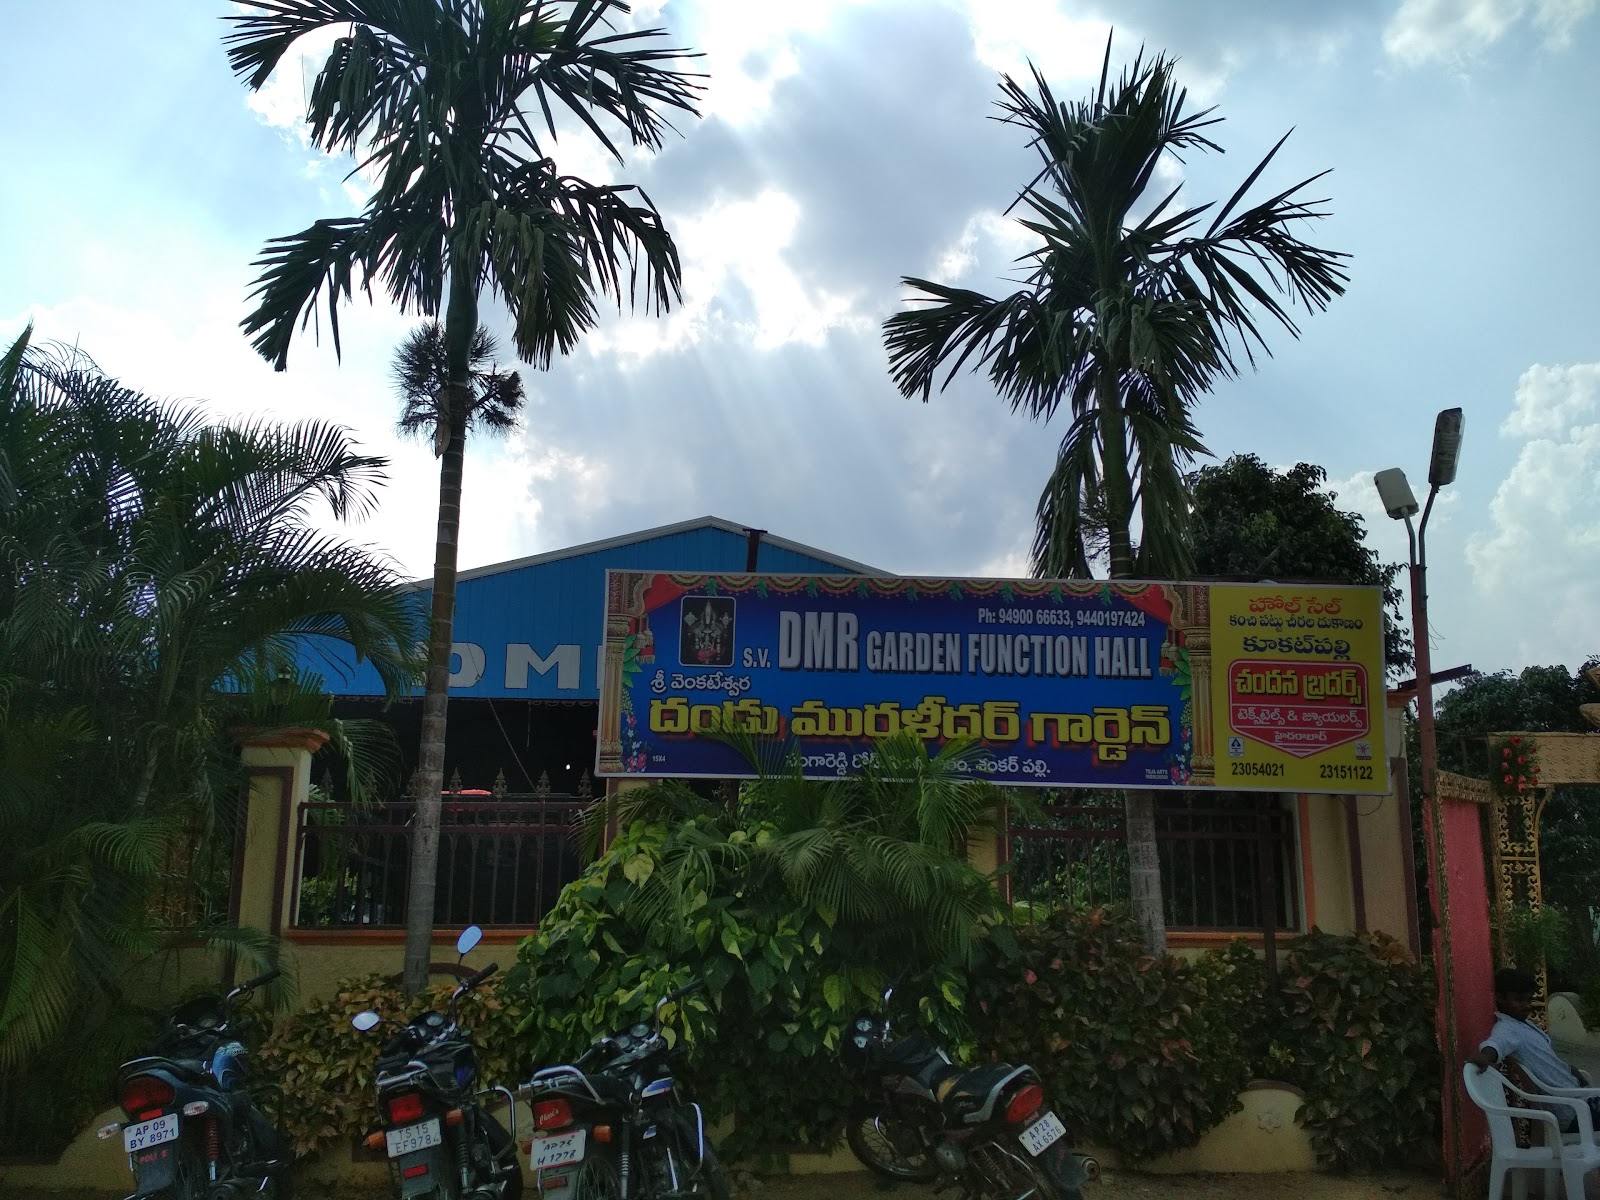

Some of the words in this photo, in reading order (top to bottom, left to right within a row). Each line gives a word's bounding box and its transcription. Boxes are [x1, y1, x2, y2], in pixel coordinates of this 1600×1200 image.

[1307, 596, 1342, 615] సేల్
[978, 608, 995, 624] Ph:
[998, 609, 1033, 625] 94900
[1036, 610, 1074, 629] 66633,
[1077, 610, 1145, 627] 9440197424
[1229, 614, 1257, 627] కంచి
[1260, 614, 1283, 632] పట్టు
[1286, 615, 1315, 629] చీరల
[1317, 616, 1363, 630] దుకాణం
[743, 647, 771, 669] S.V.
[778, 610, 860, 671] DMR
[866, 631, 961, 673] GARDEN
[968, 633, 1088, 676] FUNCTION
[1095, 636, 1152, 678] HALL
[650, 669, 668, 694] శ్రీ
[671, 671, 751, 697] వెంకటేశ్వర
[1235, 668, 1299, 696] చందన
[1302, 669, 1362, 705] బ్రదర్స్
[1287, 710, 1299, 721] &
[1030, 705, 1171, 761] గార్డెన్
[1274, 729, 1327, 743] హైదరాబాద్
[1231, 763, 1285, 776] 23054021
[1320, 764, 1373, 780] 23151122
[135, 1125, 149, 1137] AP
[153, 1119, 166, 1131] 09
[398, 1128, 411, 1141] TS
[416, 1123, 429, 1136] 15
[130, 1137, 145, 1149] BY
[150, 1128, 175, 1143] 8971
[537, 1157, 546, 1166] H
